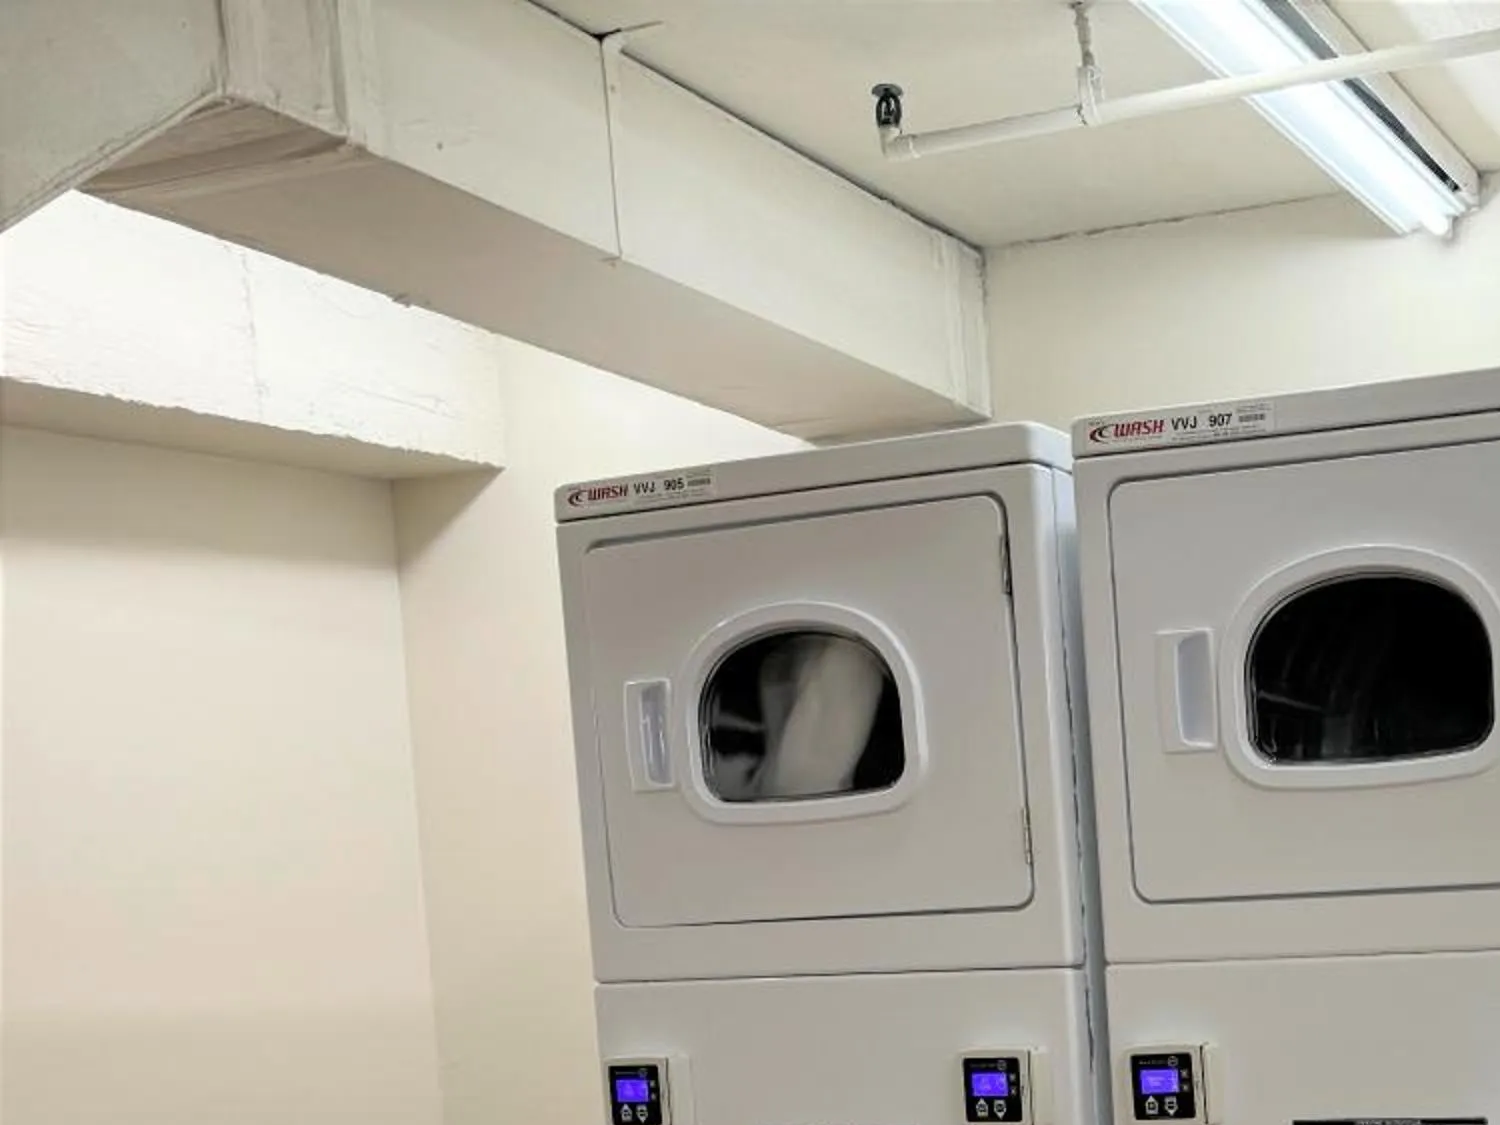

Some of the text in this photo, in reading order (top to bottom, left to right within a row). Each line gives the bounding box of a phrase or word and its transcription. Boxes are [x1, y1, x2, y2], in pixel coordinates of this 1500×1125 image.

[1113, 419, 1164, 437] WASH
[1171, 416, 1197, 431] VVJ
[1209, 413, 1232, 427] 907
[587, 487, 629, 501] WASH
[664, 477, 685, 491] 905
